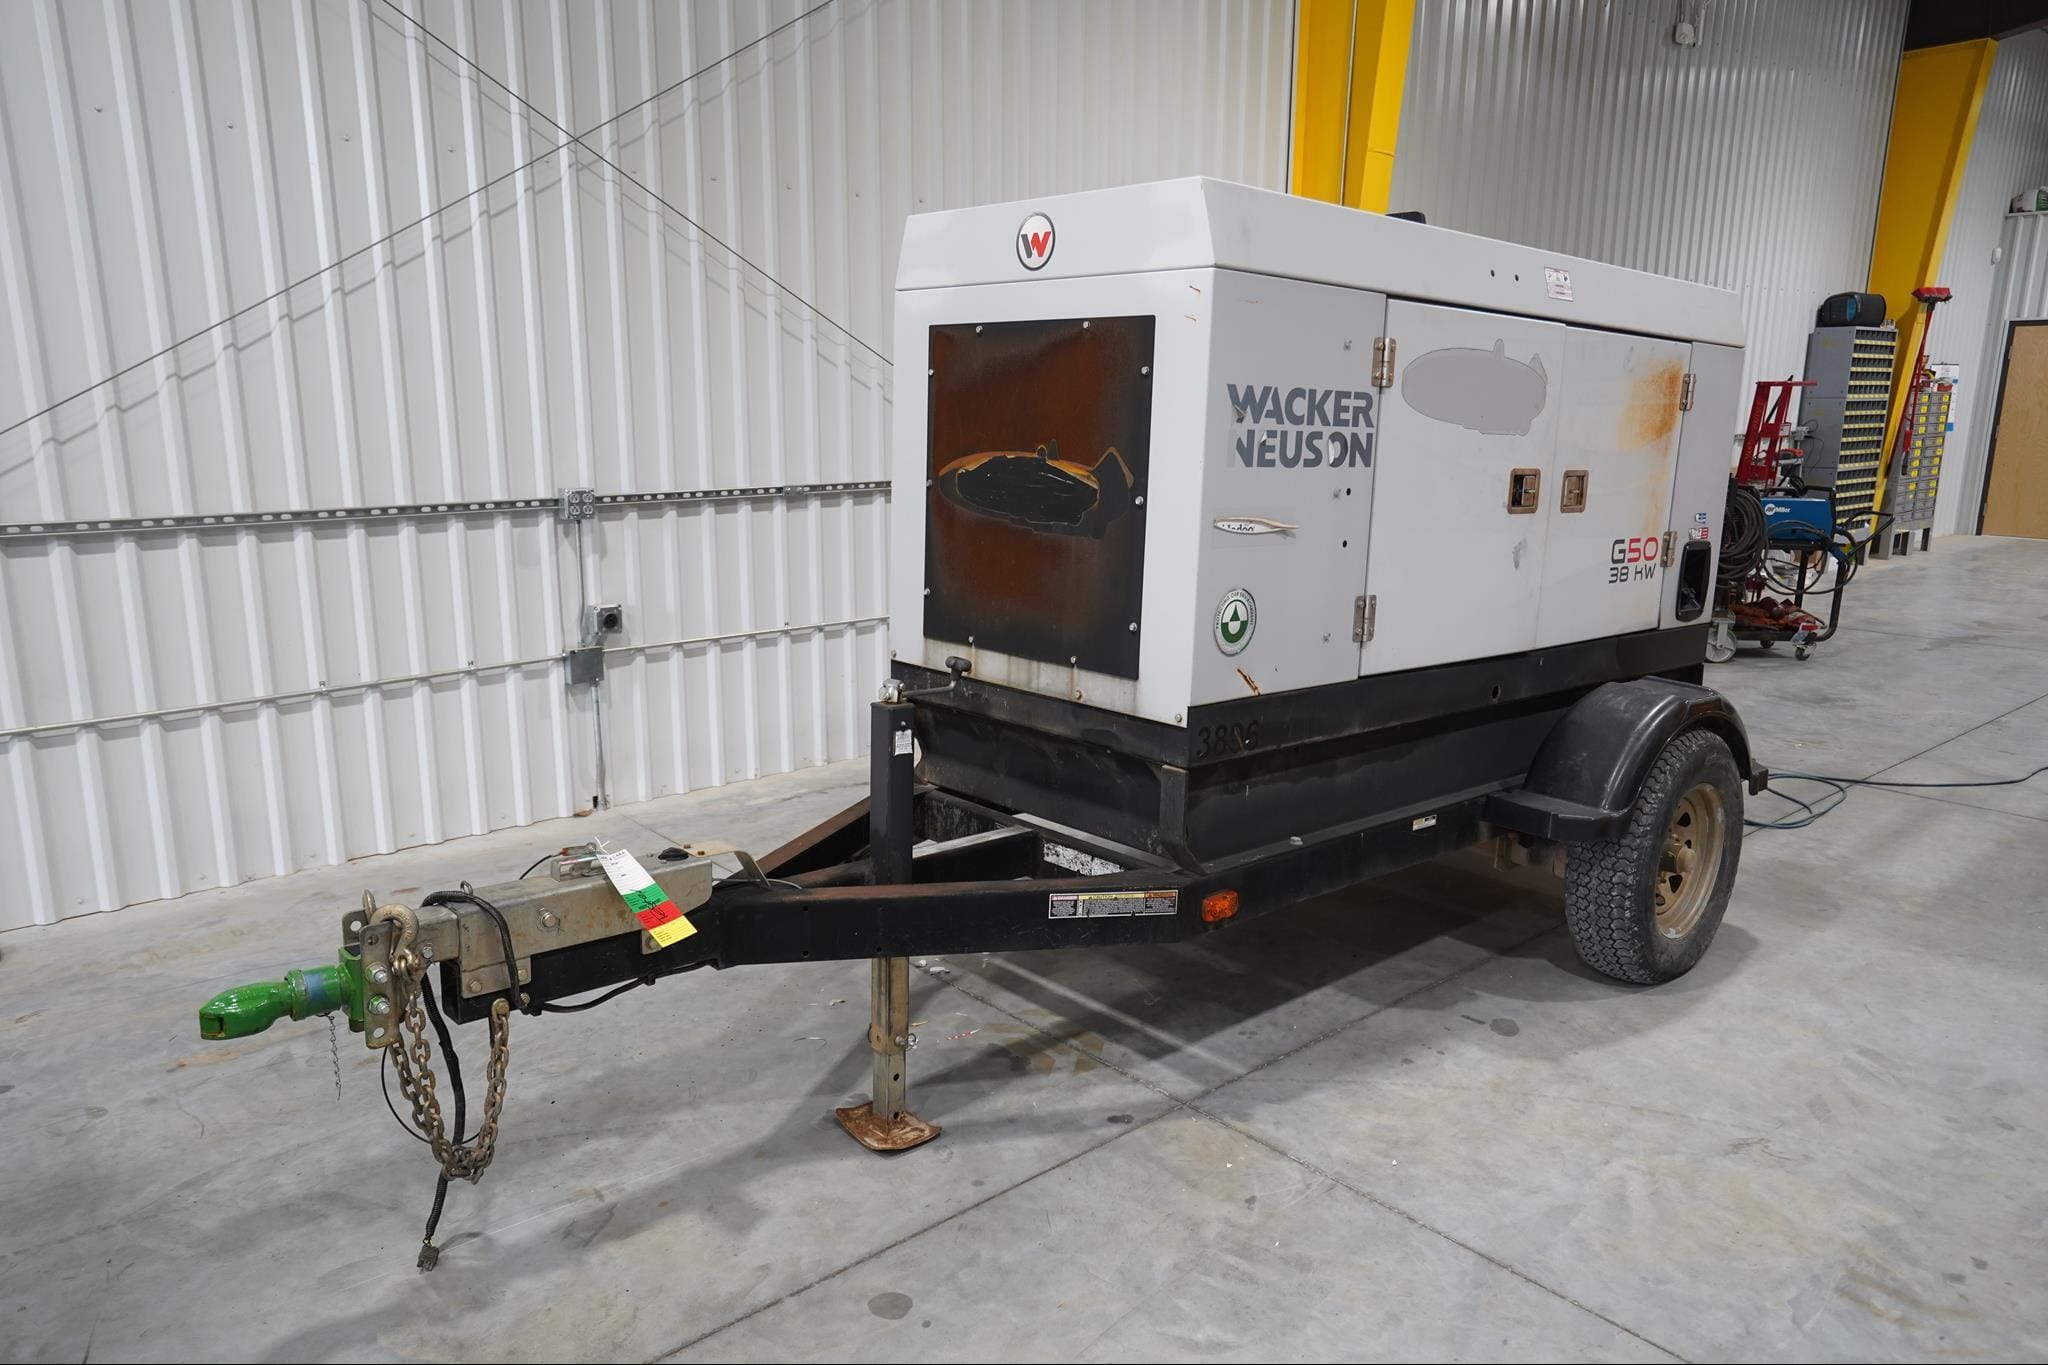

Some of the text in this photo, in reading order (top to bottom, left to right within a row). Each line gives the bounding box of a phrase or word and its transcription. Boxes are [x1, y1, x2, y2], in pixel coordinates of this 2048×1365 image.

[1226, 383, 1375, 428] WACKER
[1611, 537, 1659, 564] G50
[1608, 566, 1630, 584] 38
